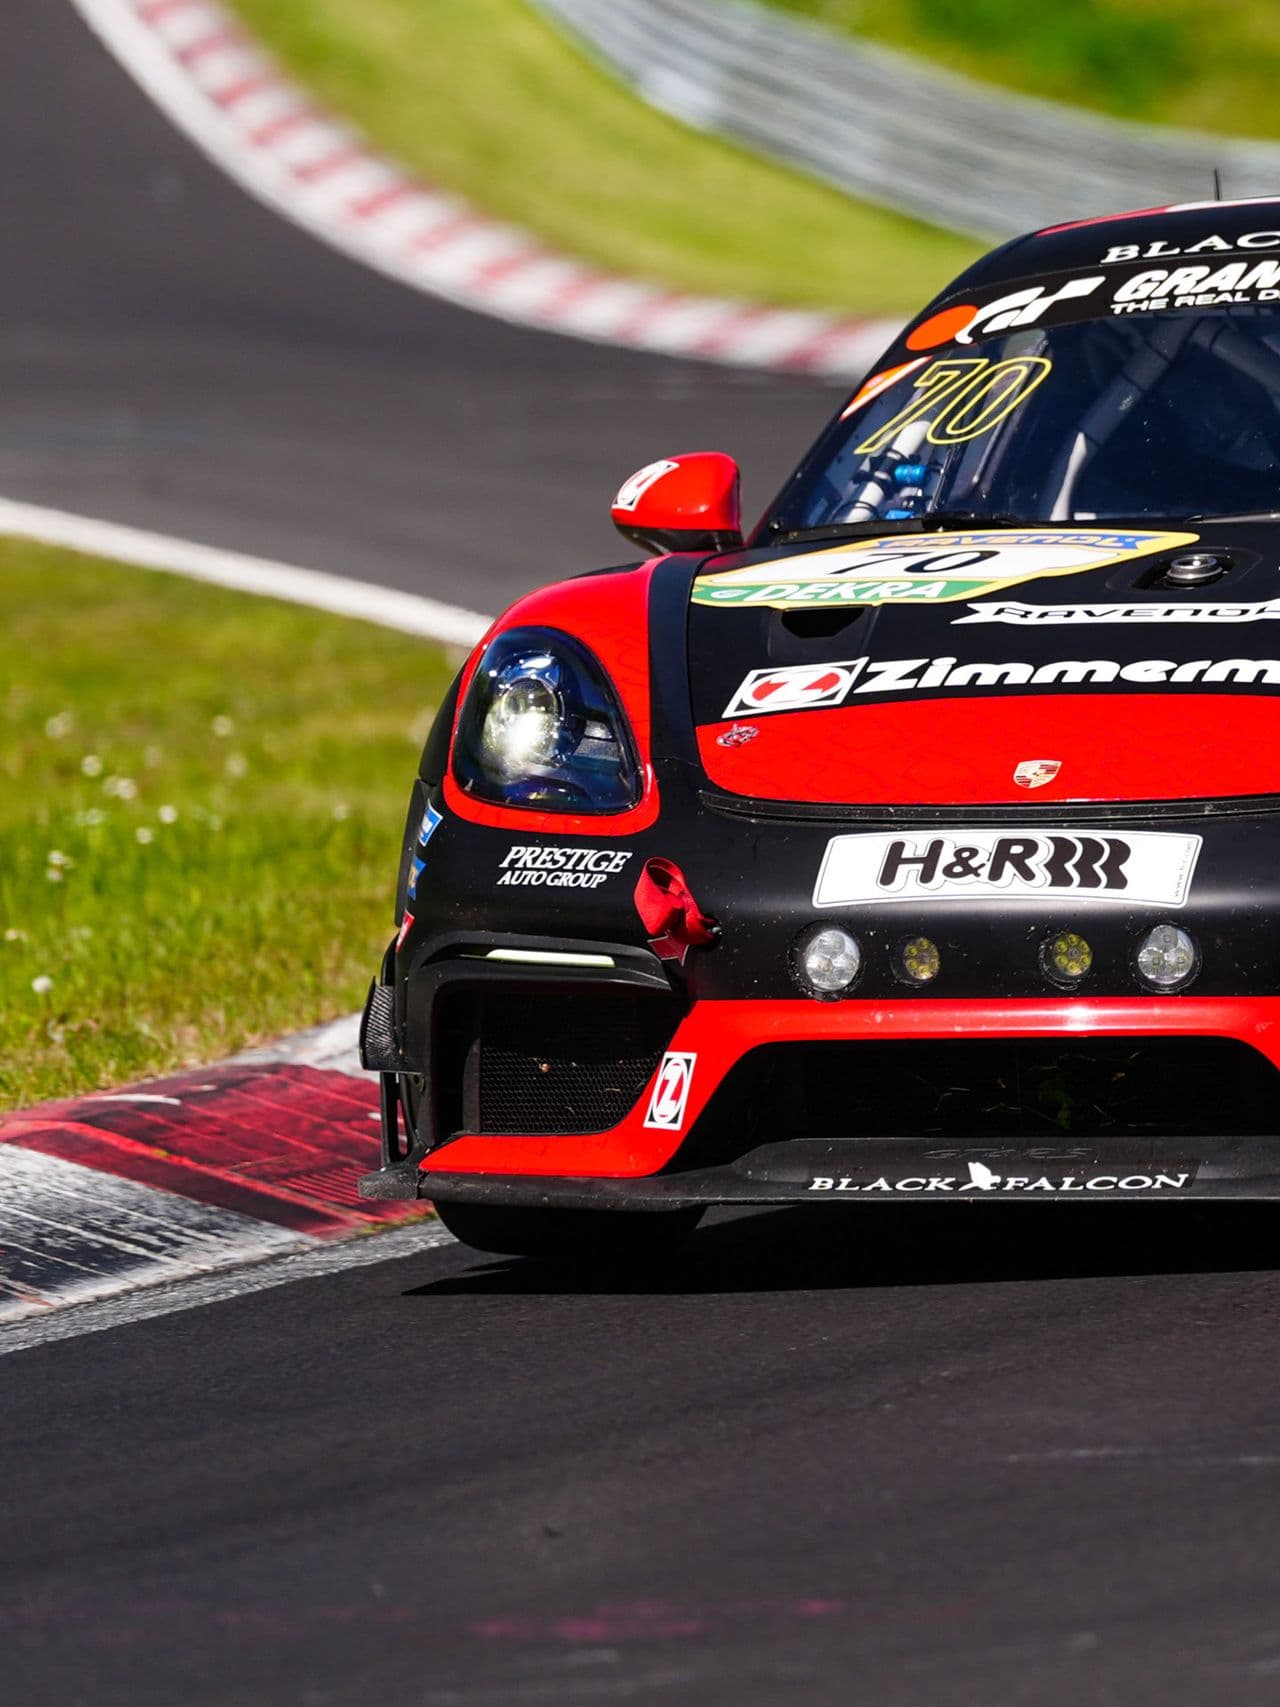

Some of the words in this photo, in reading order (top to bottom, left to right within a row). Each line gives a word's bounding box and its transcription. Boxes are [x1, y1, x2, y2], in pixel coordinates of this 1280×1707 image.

[1110, 299, 1169, 314] THE
[1174, 291, 1251, 307] REAL
[854, 356, 1052, 454] 70
[828, 550, 1000, 576] 70
[743, 580, 948, 602] DEKRA
[497, 846, 633, 873] PRESTIGE
[879, 837, 1041, 886] H&R
[496, 870, 548, 886] AUTO
[546, 873, 608, 889] GROUP
[808, 1177, 960, 1192] BLACK
[1001, 1173, 1190, 1192] FALCON
